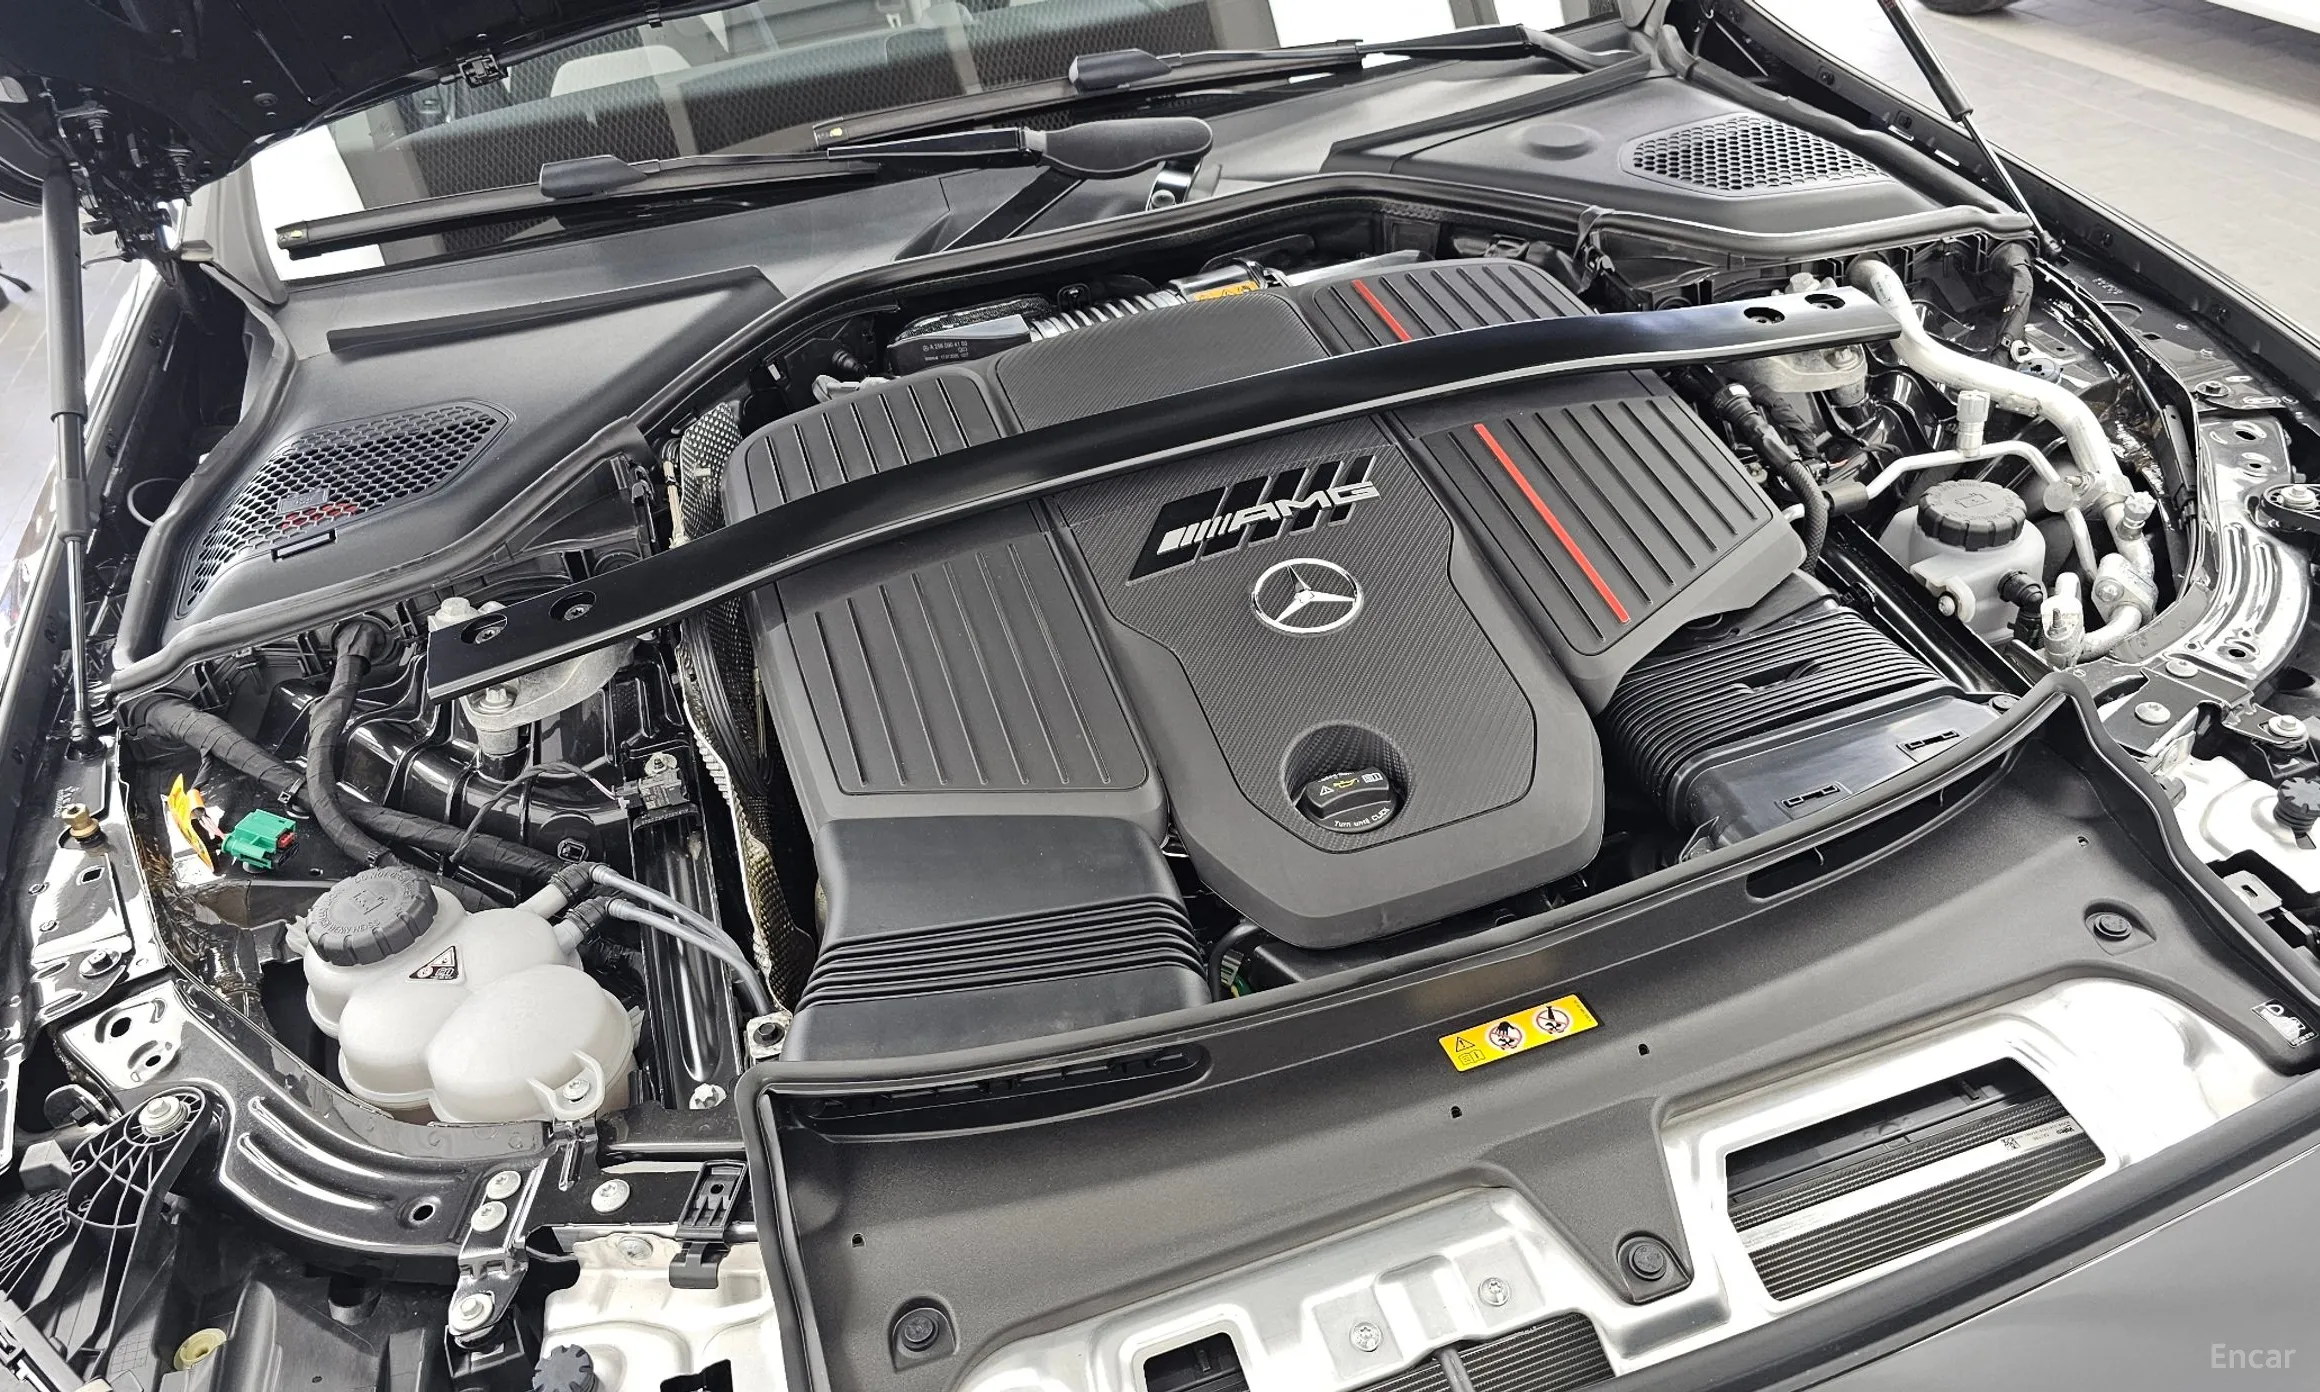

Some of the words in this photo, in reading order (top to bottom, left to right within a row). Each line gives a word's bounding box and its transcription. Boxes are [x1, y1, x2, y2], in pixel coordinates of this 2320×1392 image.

[1226, 481, 1382, 533] AMG
[1334, 820, 1351, 828] Turn
[1353, 818, 1370, 827] until
